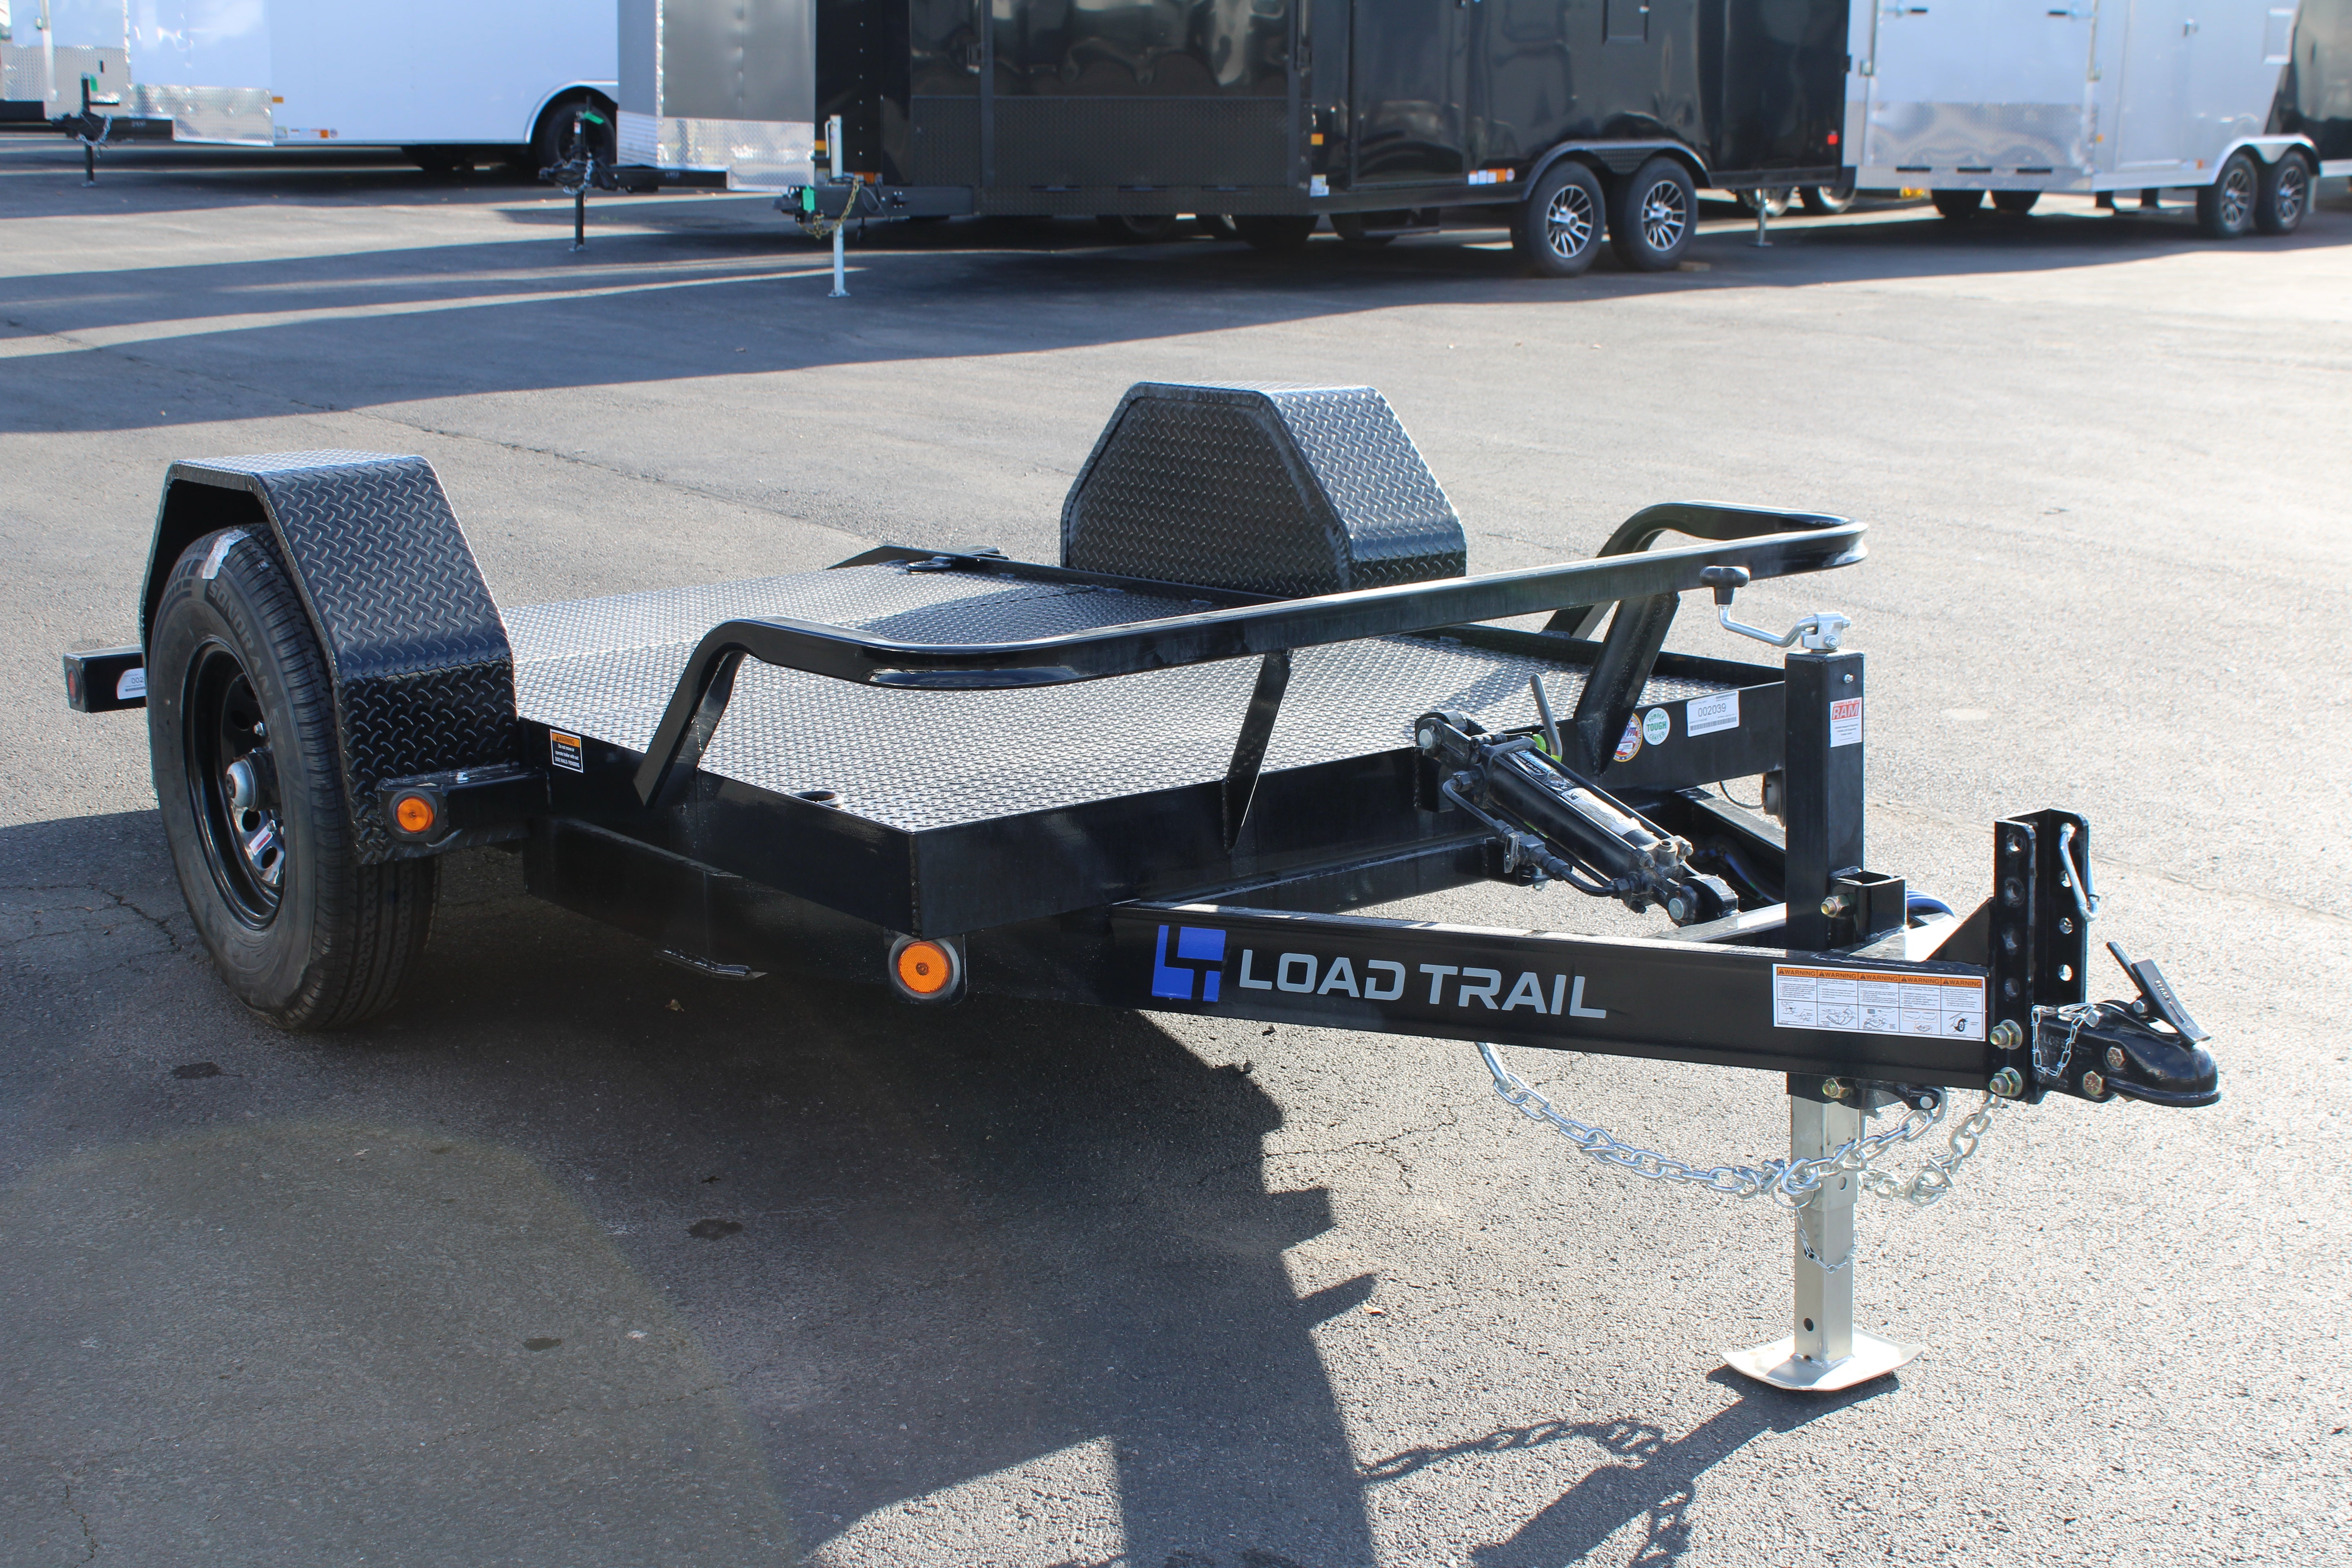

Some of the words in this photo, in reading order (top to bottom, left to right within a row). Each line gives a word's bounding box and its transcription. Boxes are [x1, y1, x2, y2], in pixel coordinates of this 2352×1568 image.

[209, 582, 273, 697] SONORAN
[1698, 703, 1726, 717] 002039
[1833, 704, 1859, 719] RAM
[1649, 713, 1665, 722] POWDER
[1646, 721, 1666, 732] TOUGH
[559, 736, 575, 744] WARNING
[1650, 731, 1664, 740] COATED
[1238, 949, 1405, 1001] LOAD
[1419, 964, 1607, 1019] TRAIL
